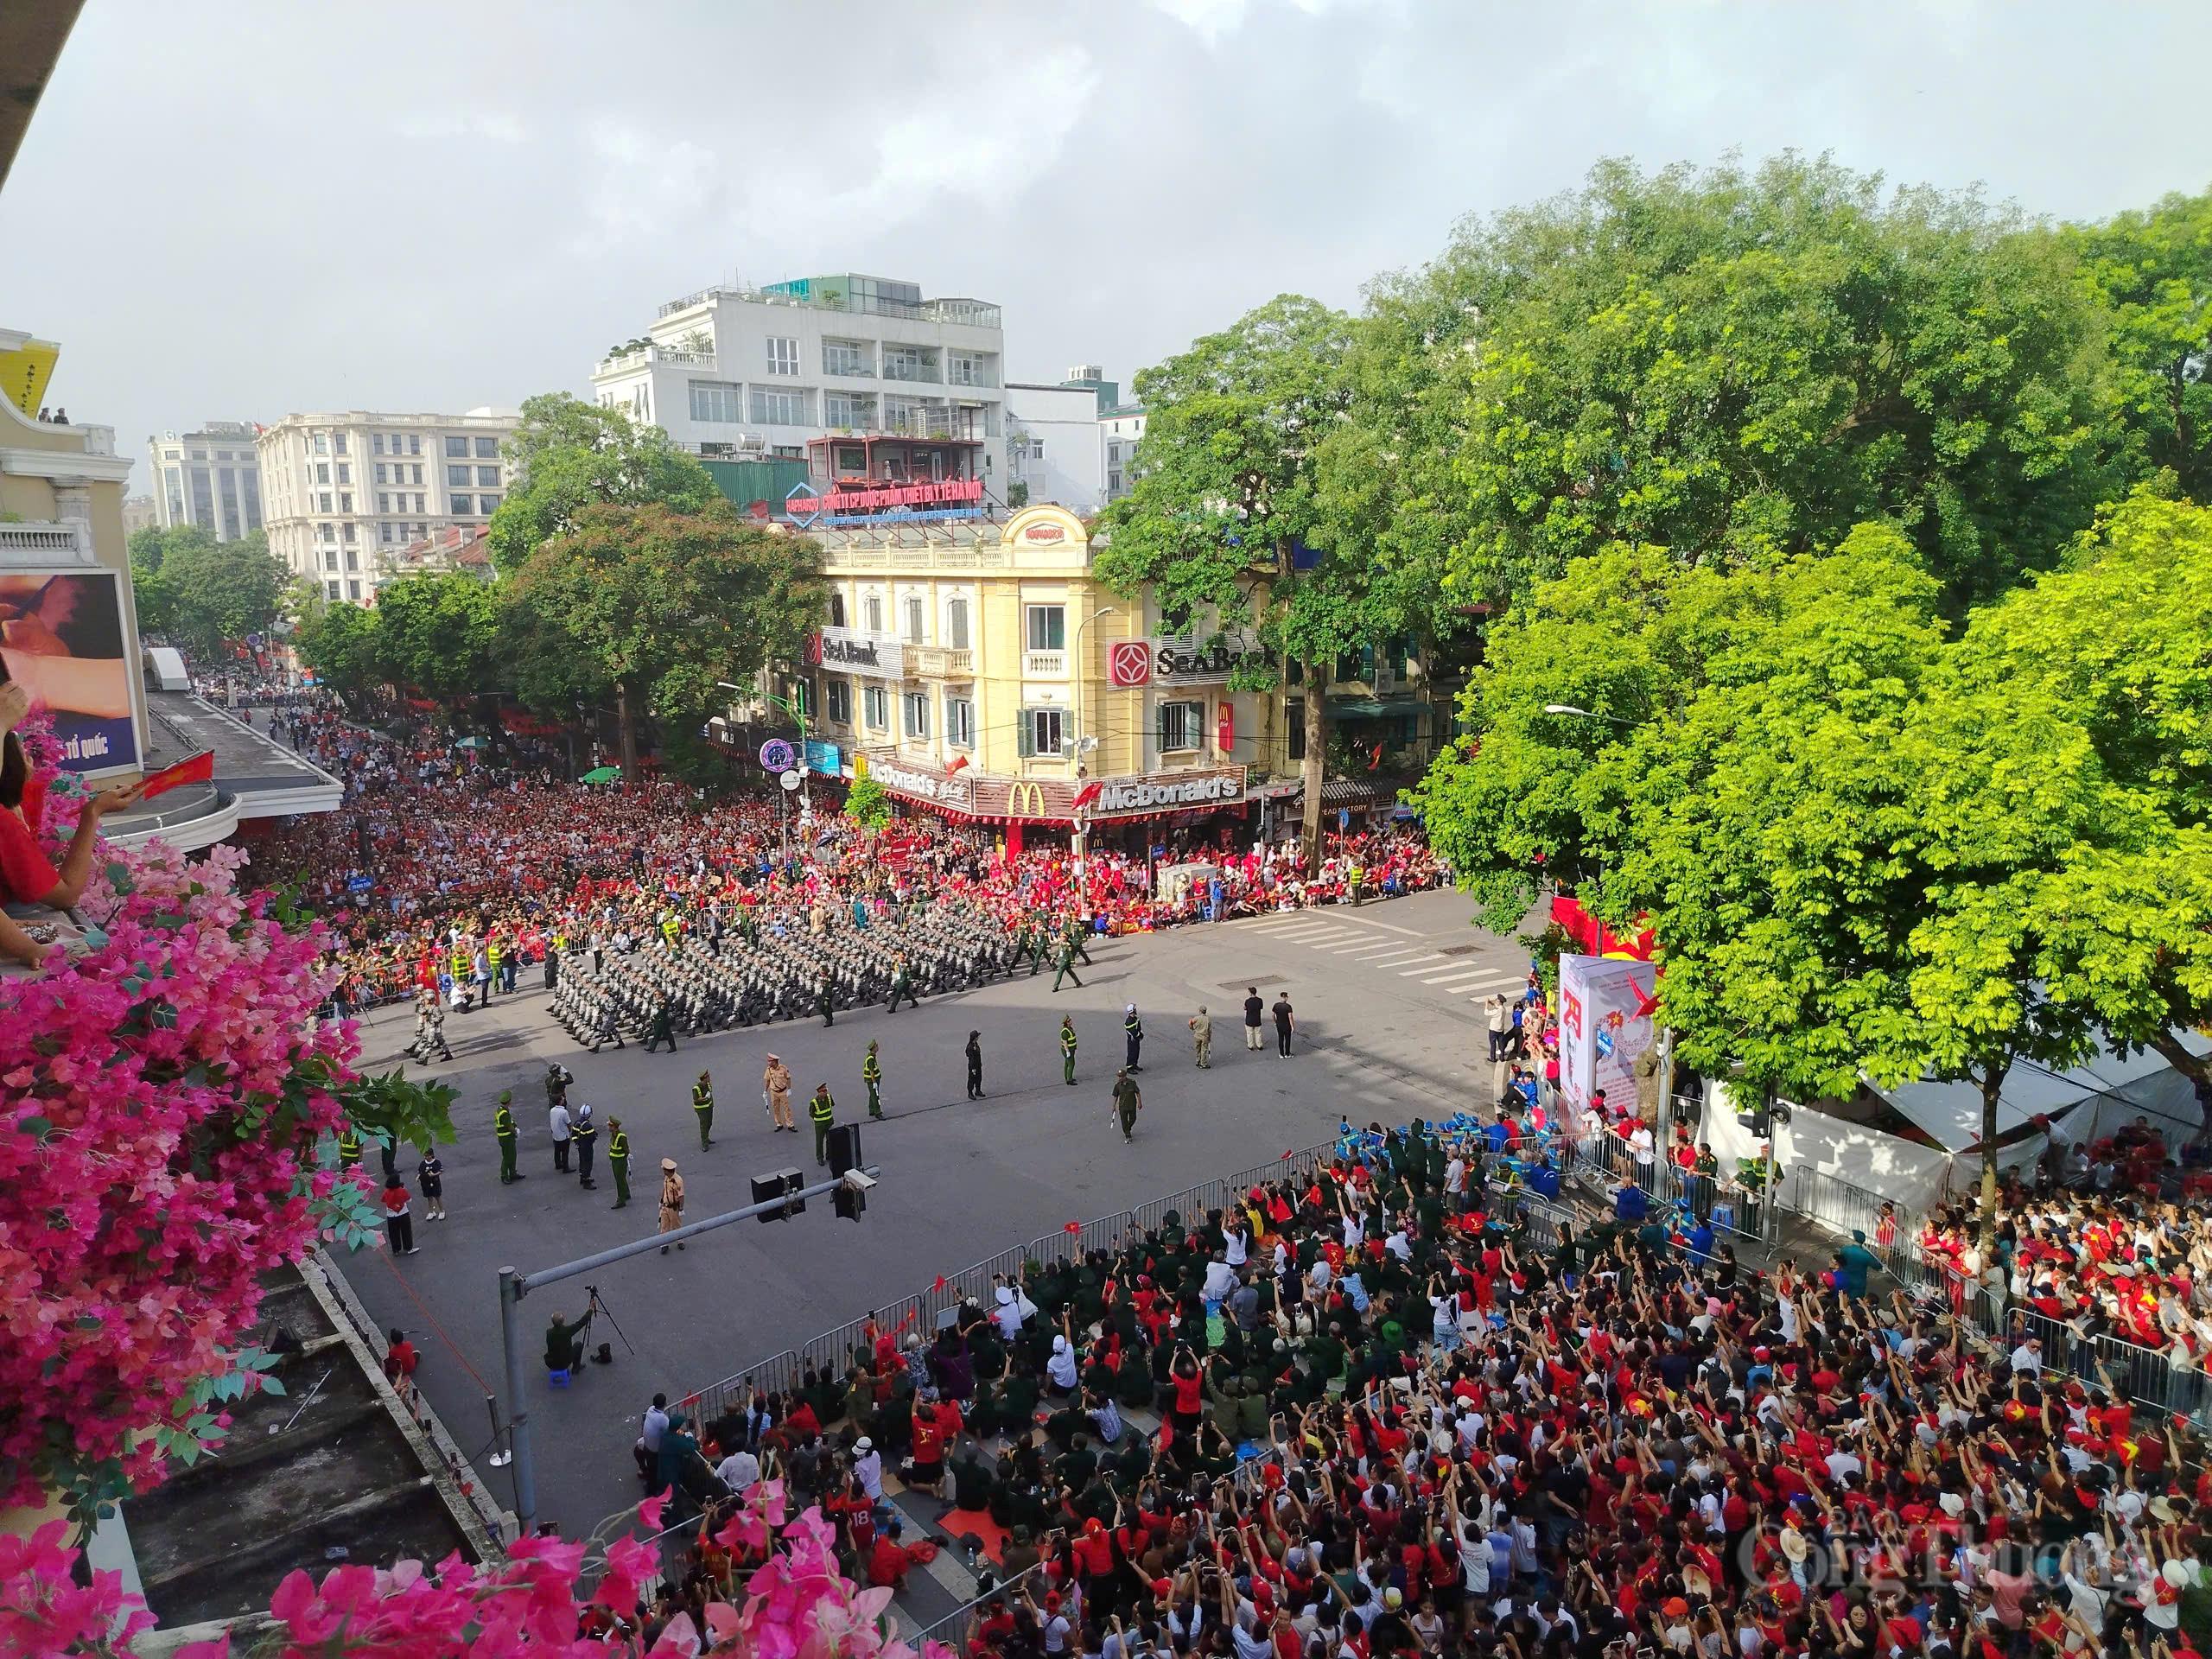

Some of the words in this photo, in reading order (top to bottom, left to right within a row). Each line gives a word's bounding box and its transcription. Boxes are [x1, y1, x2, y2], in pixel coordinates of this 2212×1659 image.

[1157, 645, 1280, 675] SeABak
[1098, 775, 1237, 810] McDonald's
[852, 1510, 868, 1527] 18
